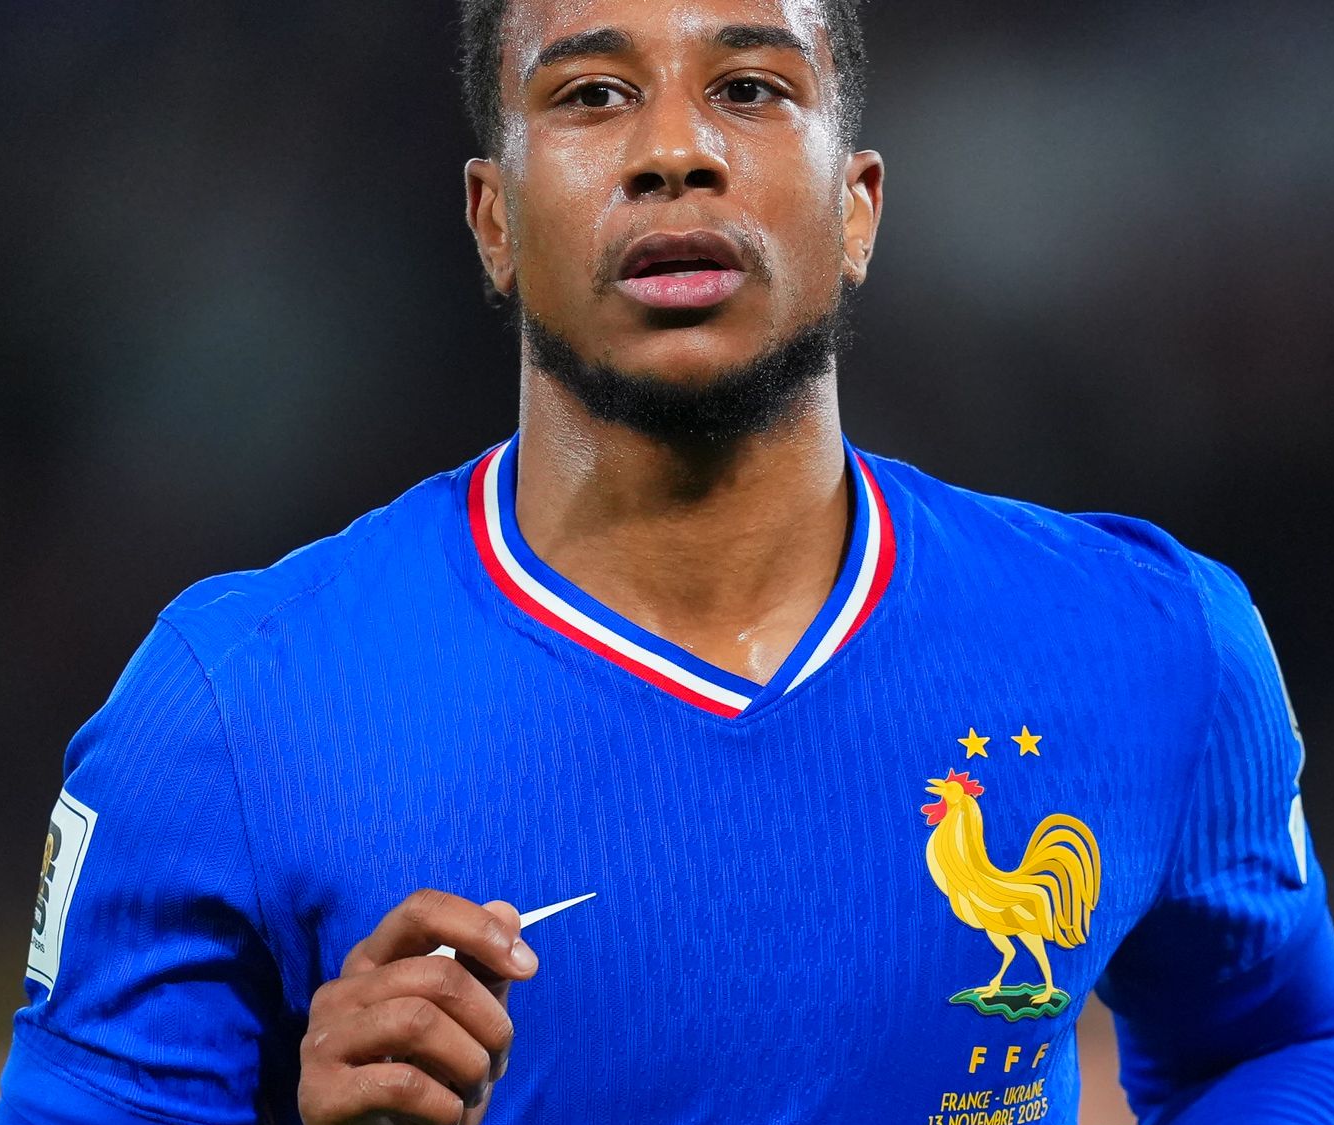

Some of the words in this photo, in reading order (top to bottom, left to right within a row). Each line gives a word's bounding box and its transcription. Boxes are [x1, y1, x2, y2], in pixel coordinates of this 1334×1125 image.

[940, 1090, 993, 1112] FRANCE
[1003, 1078, 1046, 1106] UKRAINE
[1016, 1097, 1049, 1125] 2025
